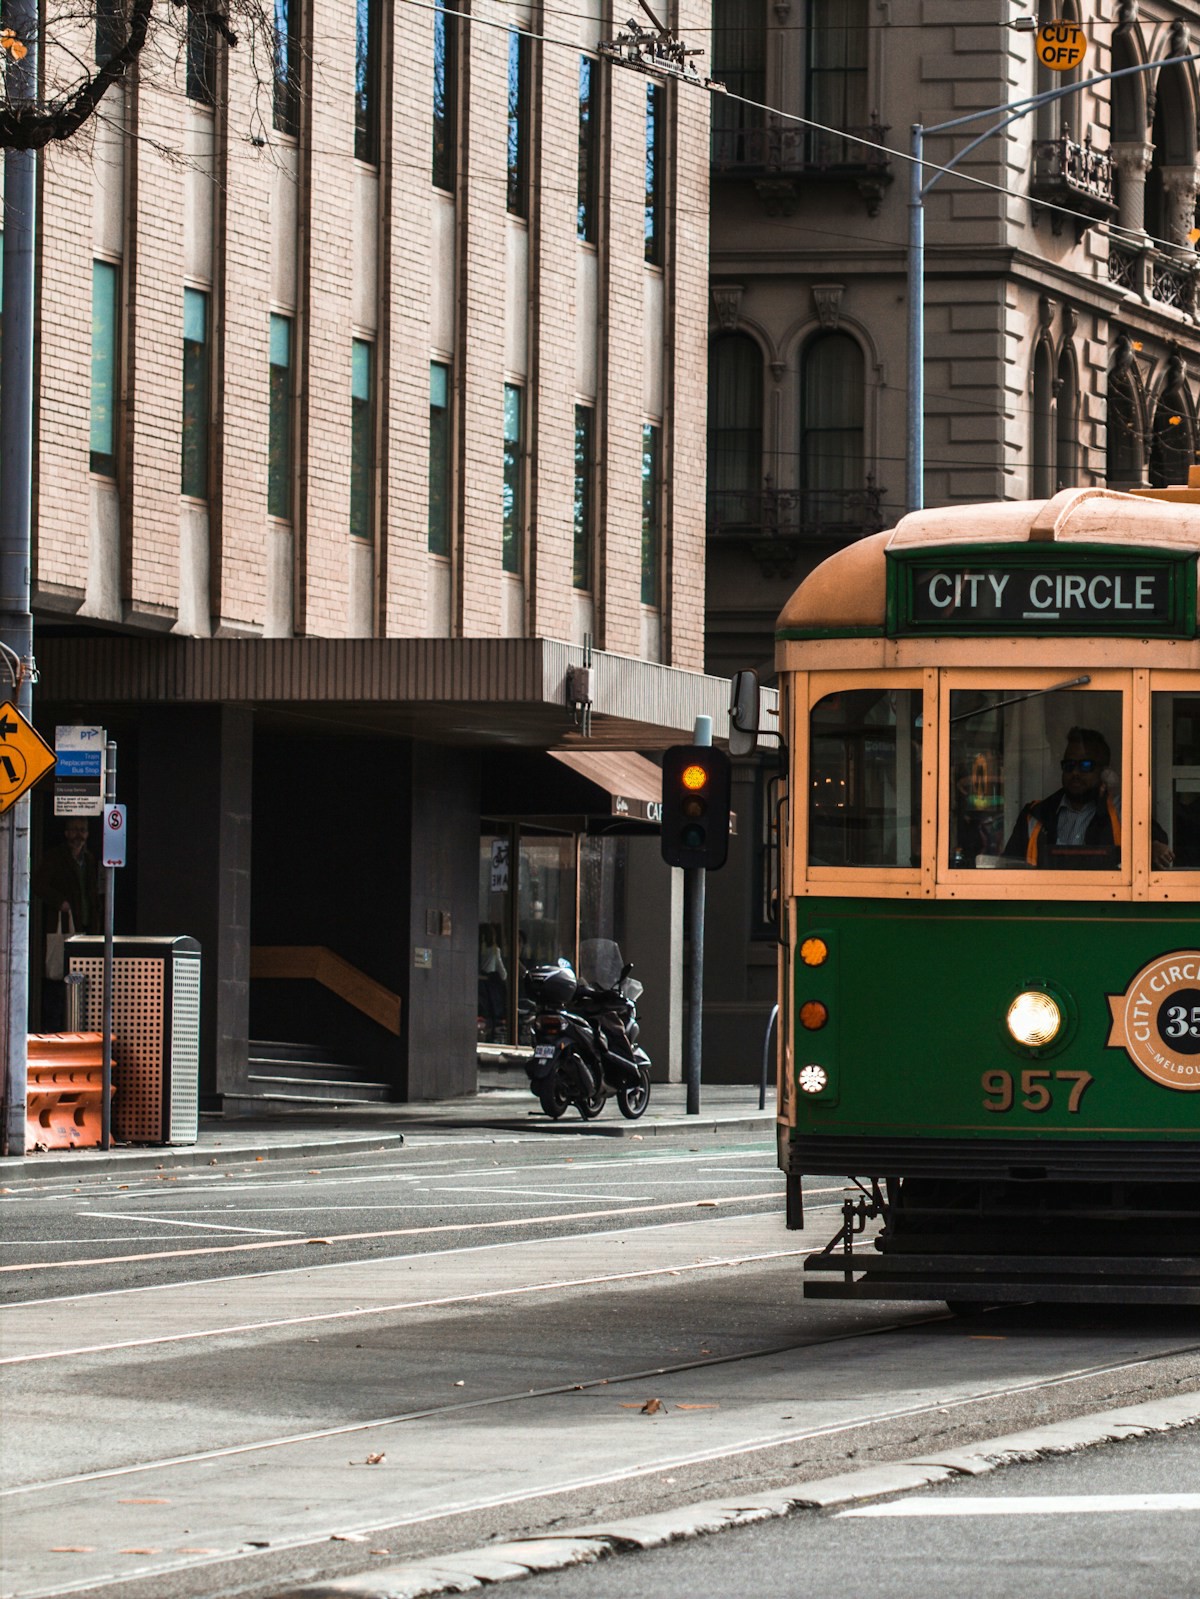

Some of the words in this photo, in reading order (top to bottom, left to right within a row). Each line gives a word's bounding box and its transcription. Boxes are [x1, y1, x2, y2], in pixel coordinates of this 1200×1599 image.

[1042, 25, 1081, 43] CUT
[1042, 46, 1079, 64] OFF
[928, 573, 1010, 608] CITY
[1029, 574, 1156, 610] CIRCLE
[60, 759, 100, 767] Replacement
[85, 766, 100, 775] Stop
[1133, 992, 1153, 1042] CITY
[981, 1069, 1095, 1113] 957
